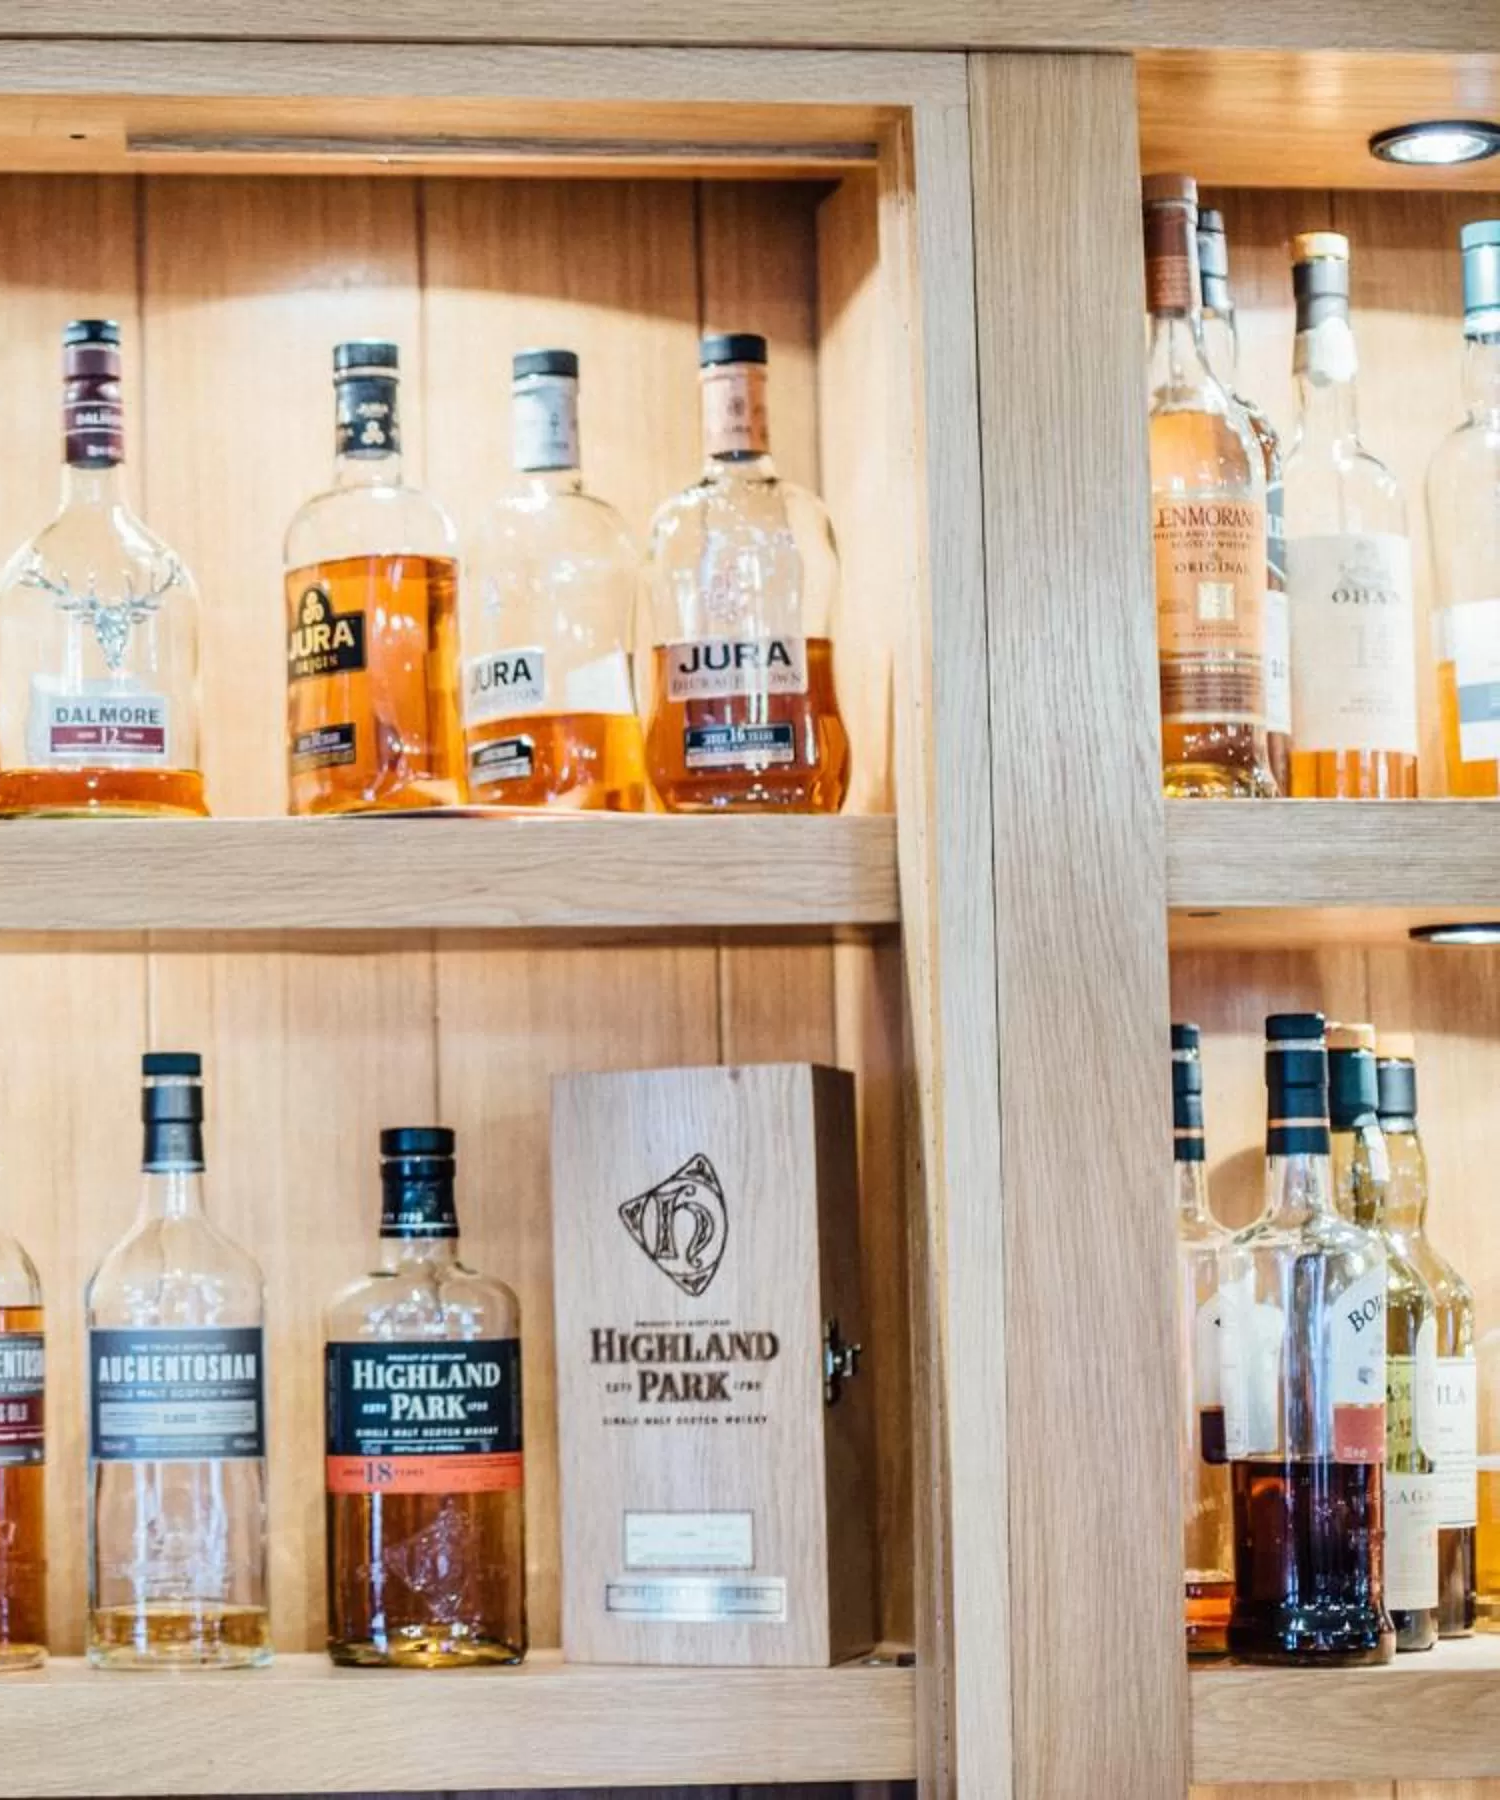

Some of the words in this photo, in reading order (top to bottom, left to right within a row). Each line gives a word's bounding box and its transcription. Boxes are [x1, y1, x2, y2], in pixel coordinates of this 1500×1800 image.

[290, 619, 355, 661] JURA
[679, 639, 792, 674] JURA
[471, 657, 532, 695] JURA
[55, 707, 161, 725] DALMORE
[101, 727, 119, 745] 12
[590, 1327, 780, 1364] HIGHLAND
[98, 1353, 257, 1383] AUCHENTOSHAN
[351, 1358, 501, 1390] HIGHLAND
[637, 1369, 732, 1403] PARK
[389, 1392, 468, 1421] PARK
[365, 1461, 393, 1485] 18
